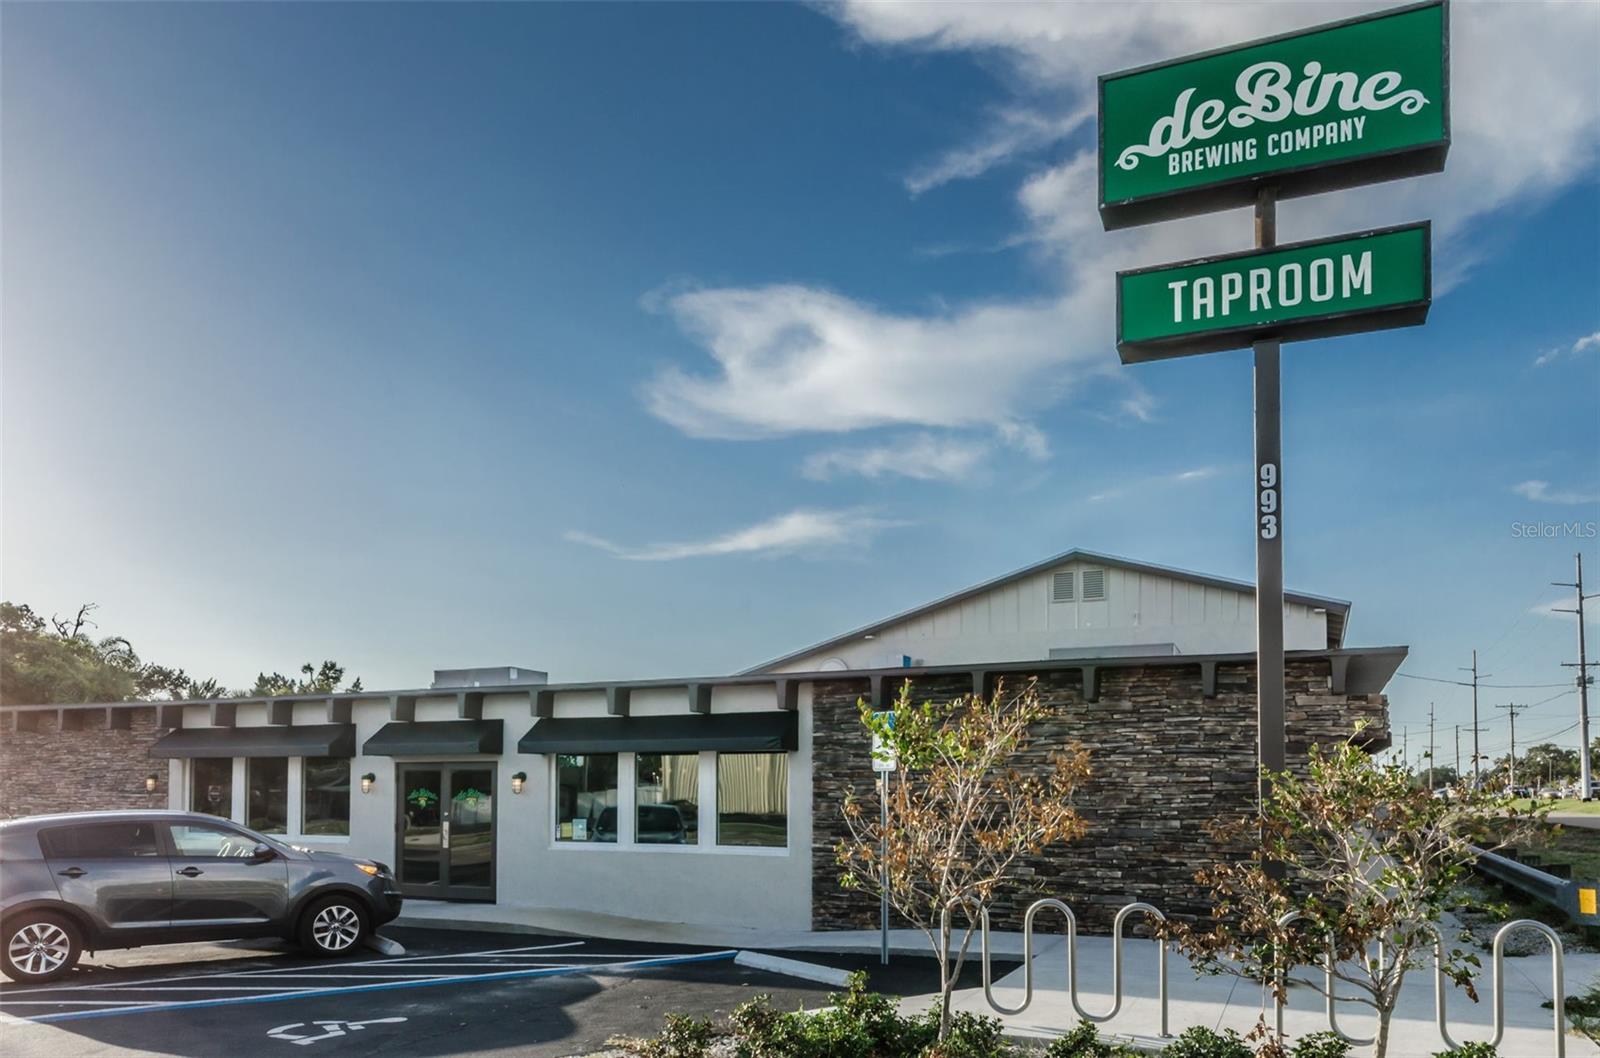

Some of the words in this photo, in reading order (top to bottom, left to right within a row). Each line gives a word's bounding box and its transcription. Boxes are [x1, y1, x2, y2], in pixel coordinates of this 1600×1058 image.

[1114, 61, 1430, 170] deBine
[1168, 138, 1257, 175] BREWING
[1267, 116, 1366, 156] COMPANY
[1168, 251, 1372, 323] TAPROOM
[1260, 463, 1277, 539] 993
